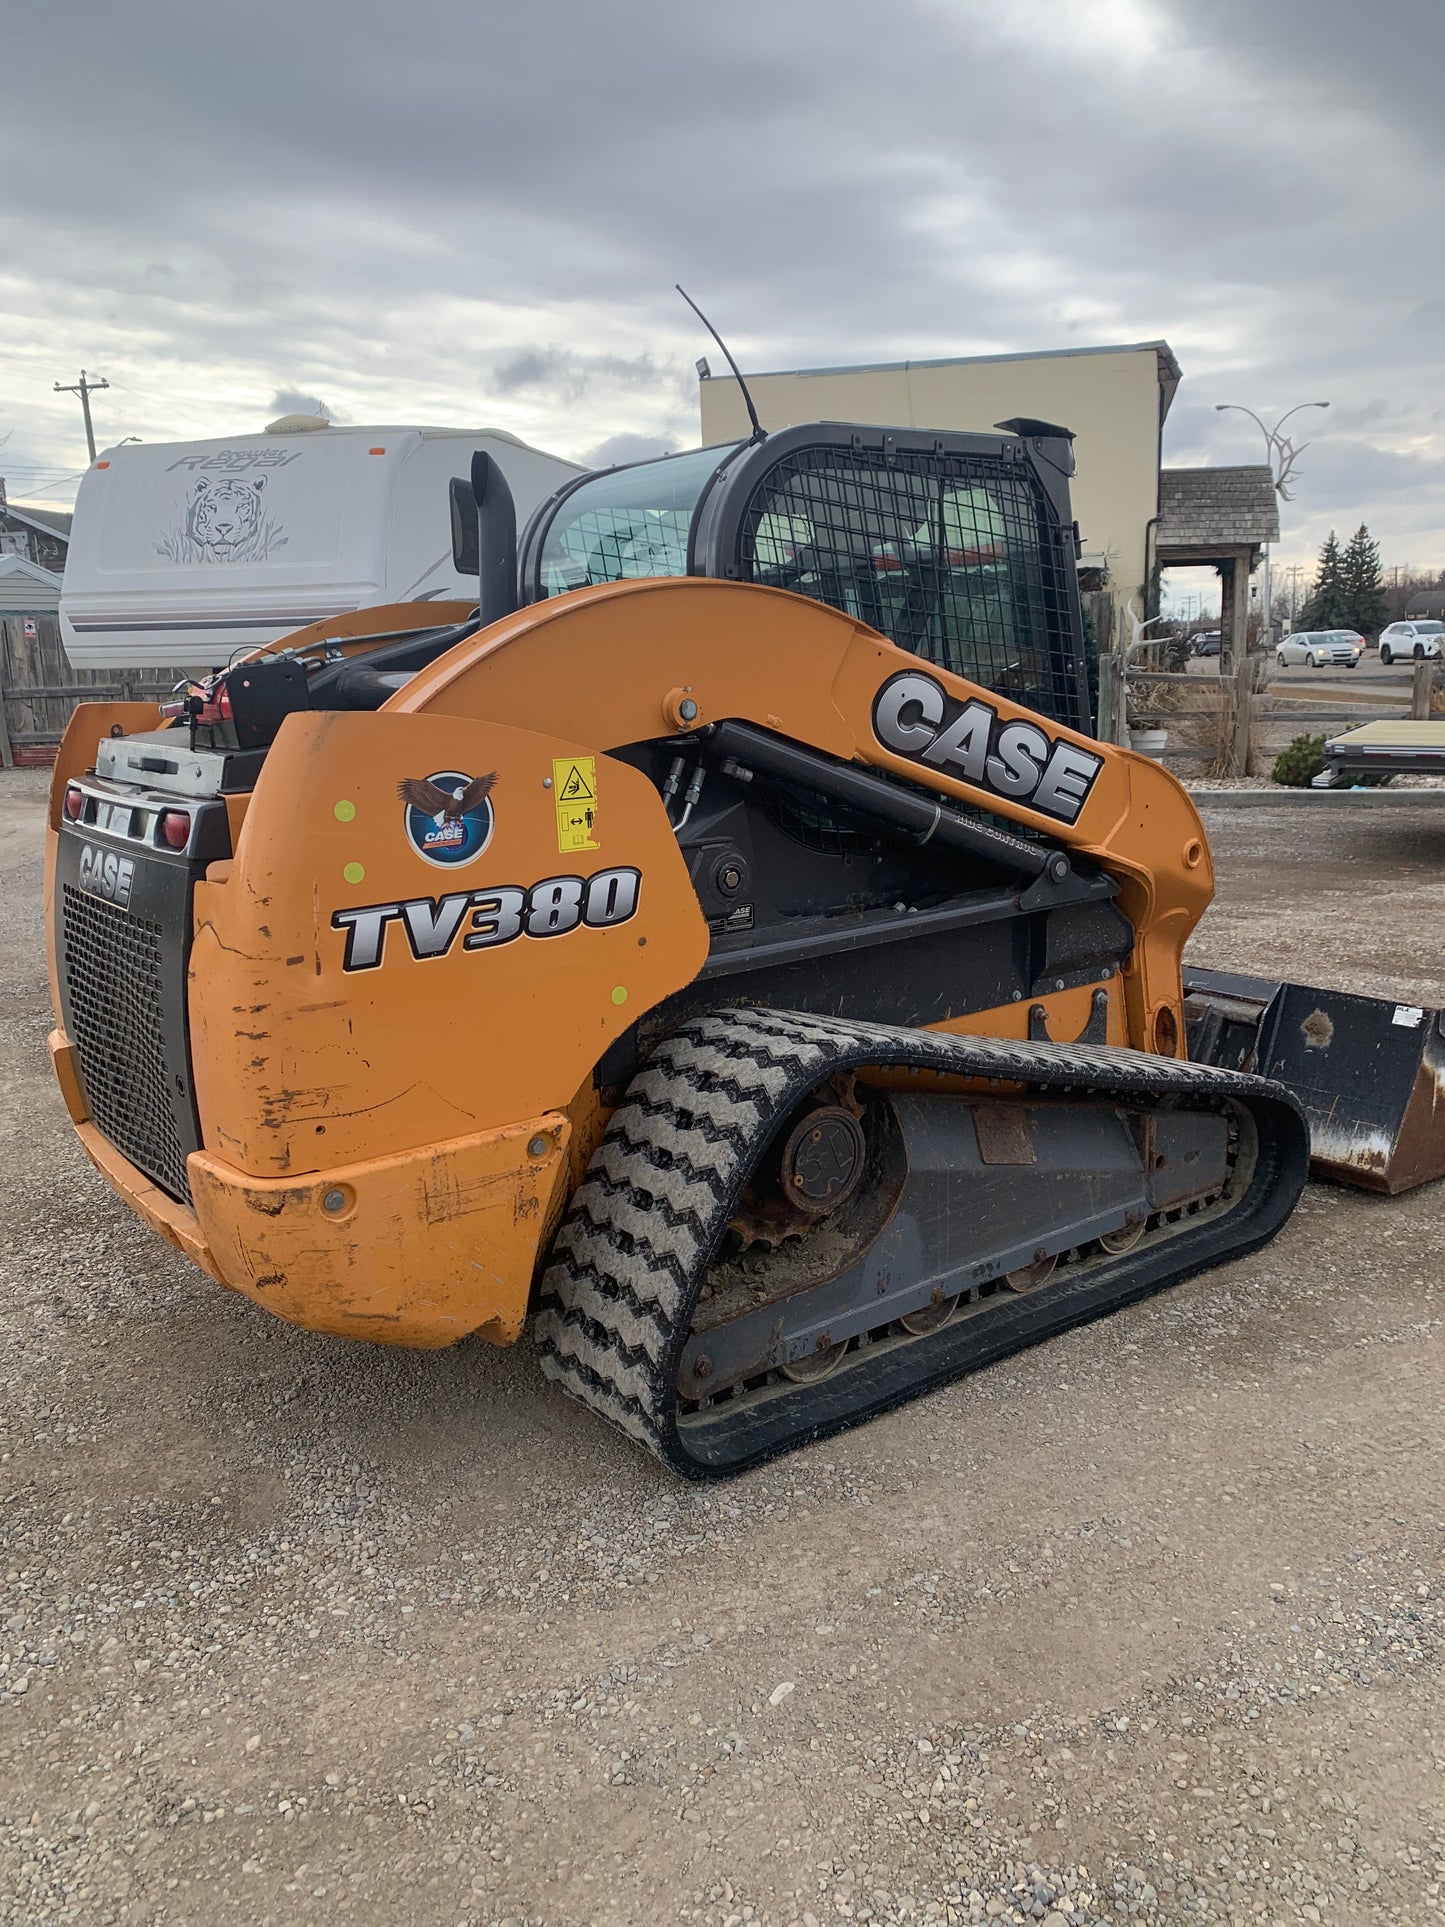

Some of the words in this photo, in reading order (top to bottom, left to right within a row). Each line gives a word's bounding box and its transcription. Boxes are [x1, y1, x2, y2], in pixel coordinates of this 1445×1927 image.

[165, 452, 303, 473] Regal
[217, 448, 288, 460] Prowler
[875, 674, 1101, 820] CASE
[424, 828, 463, 842] CASE
[80, 844, 134, 905] CASE
[333, 868, 642, 971] TV380
